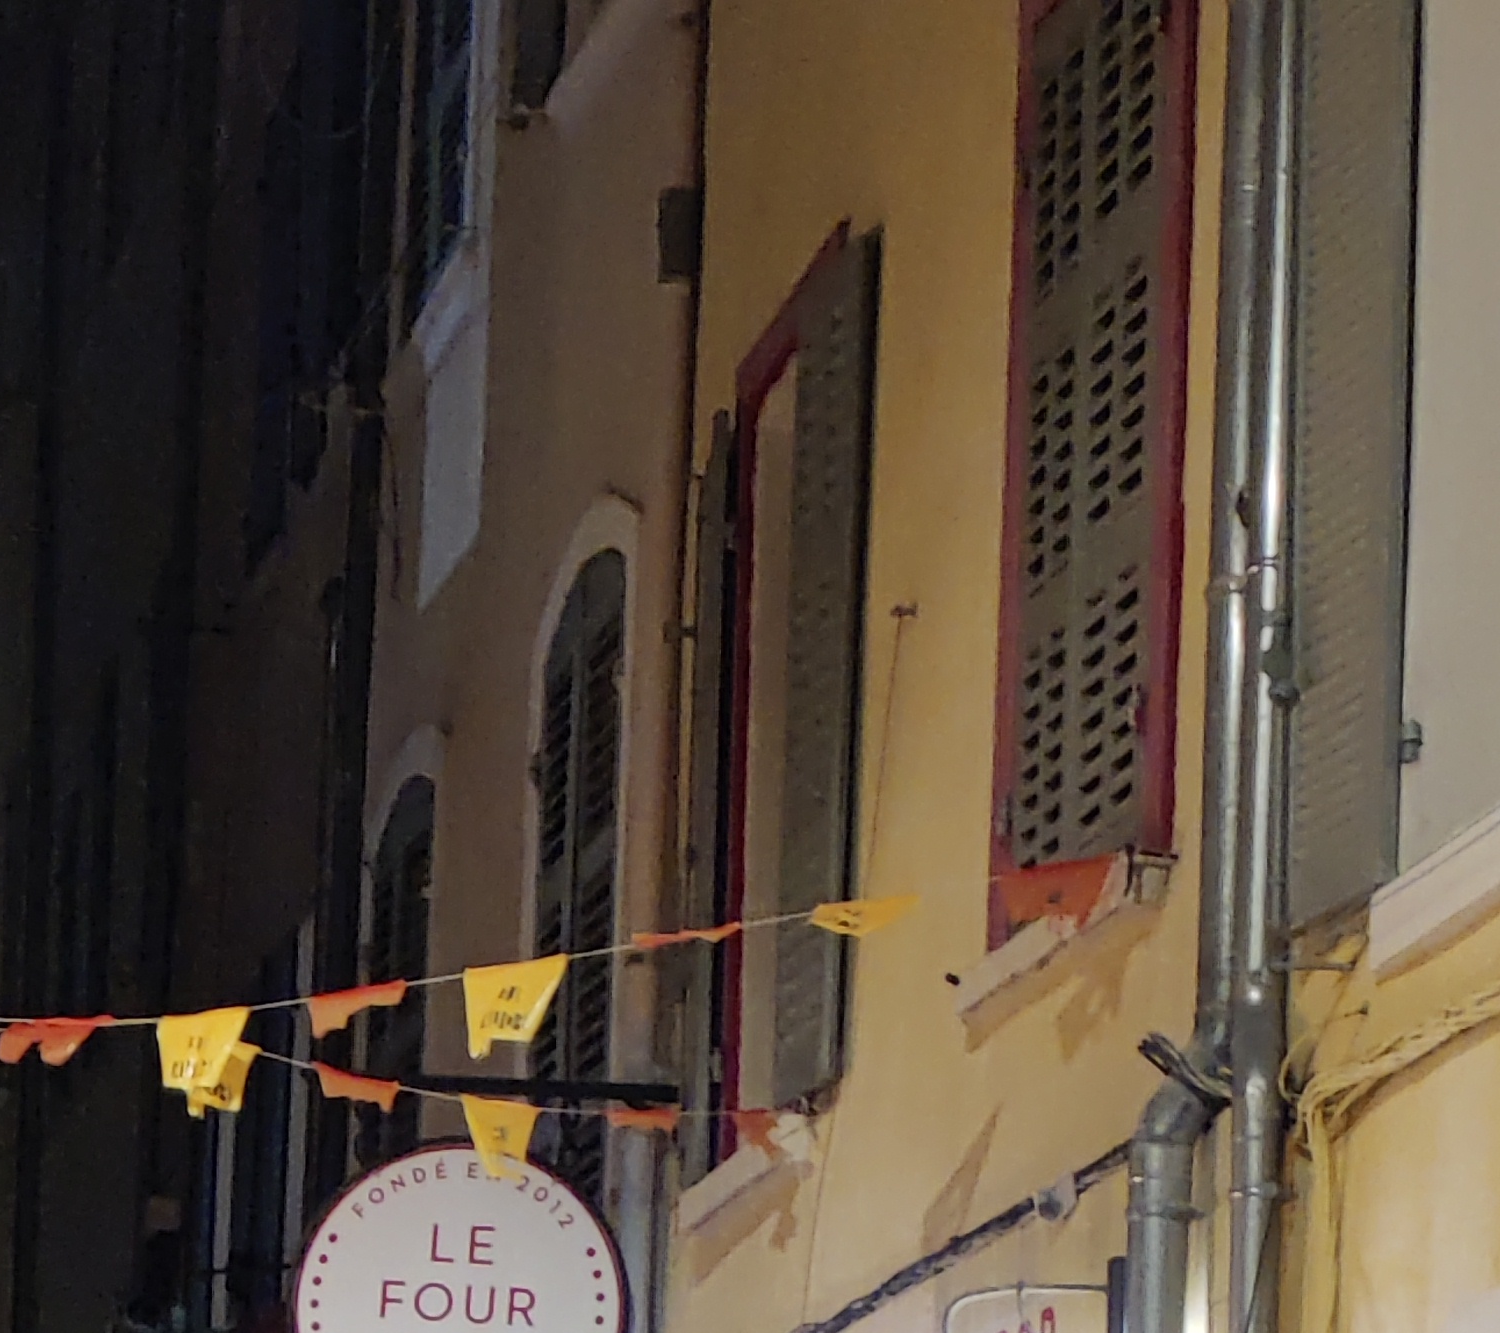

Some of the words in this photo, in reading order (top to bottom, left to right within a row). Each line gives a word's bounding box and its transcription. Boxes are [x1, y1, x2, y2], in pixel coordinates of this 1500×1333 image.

[351, 1157, 448, 1219] FONDÉ
[515, 1174, 575, 1230] 2012
[430, 1223, 496, 1266] LE
[379, 1279, 537, 1328] FOUR
